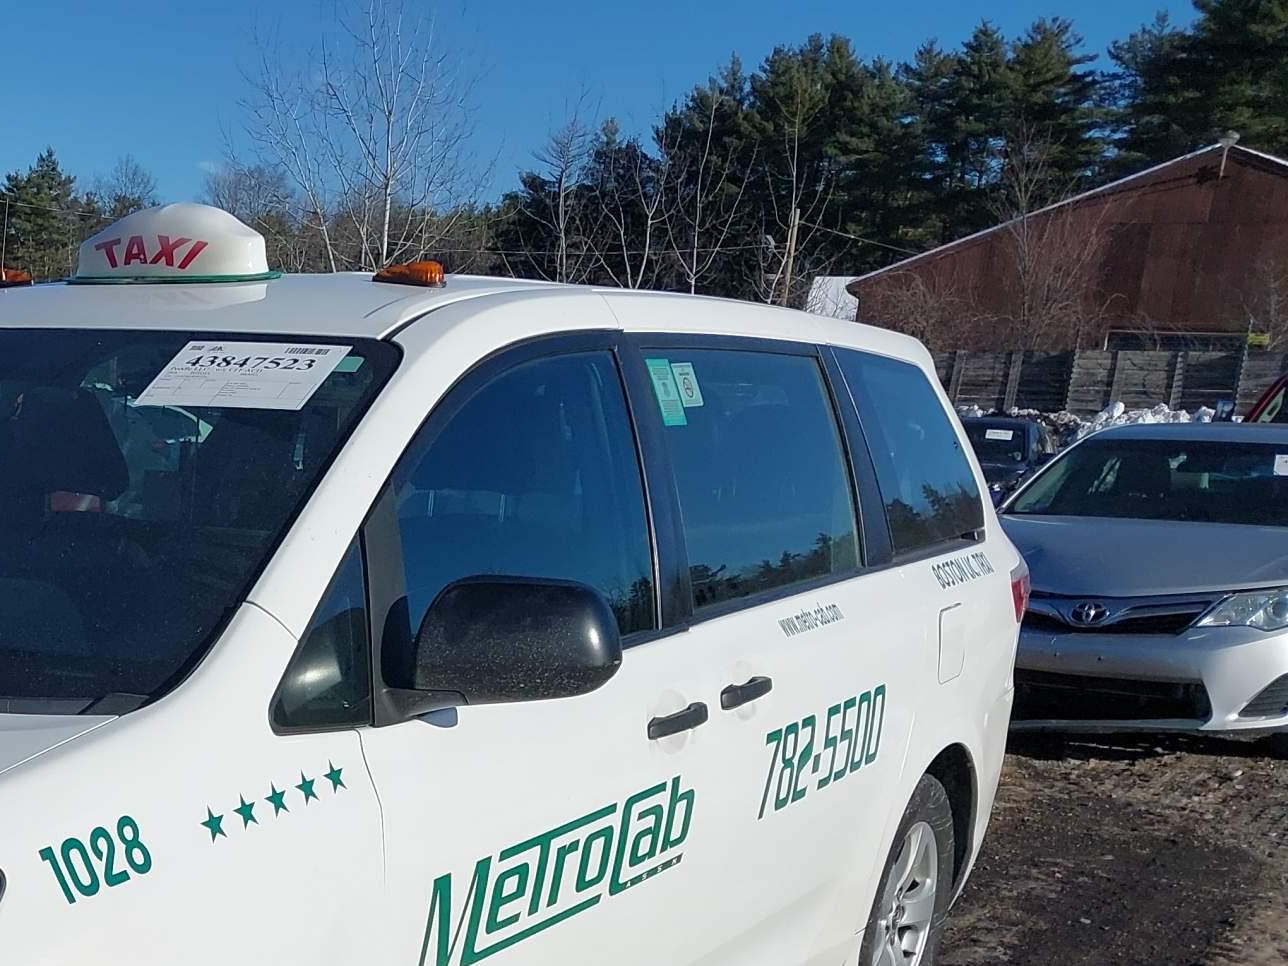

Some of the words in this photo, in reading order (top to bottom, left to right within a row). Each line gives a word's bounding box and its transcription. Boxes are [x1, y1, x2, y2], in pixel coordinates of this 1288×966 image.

[95, 234, 209, 269] TAXI
[185, 354, 317, 371] 43847523
[931, 558, 970, 590] BOSTON
[757, 684, 886, 820] 782-5500
[39, 815, 152, 904] 1028
